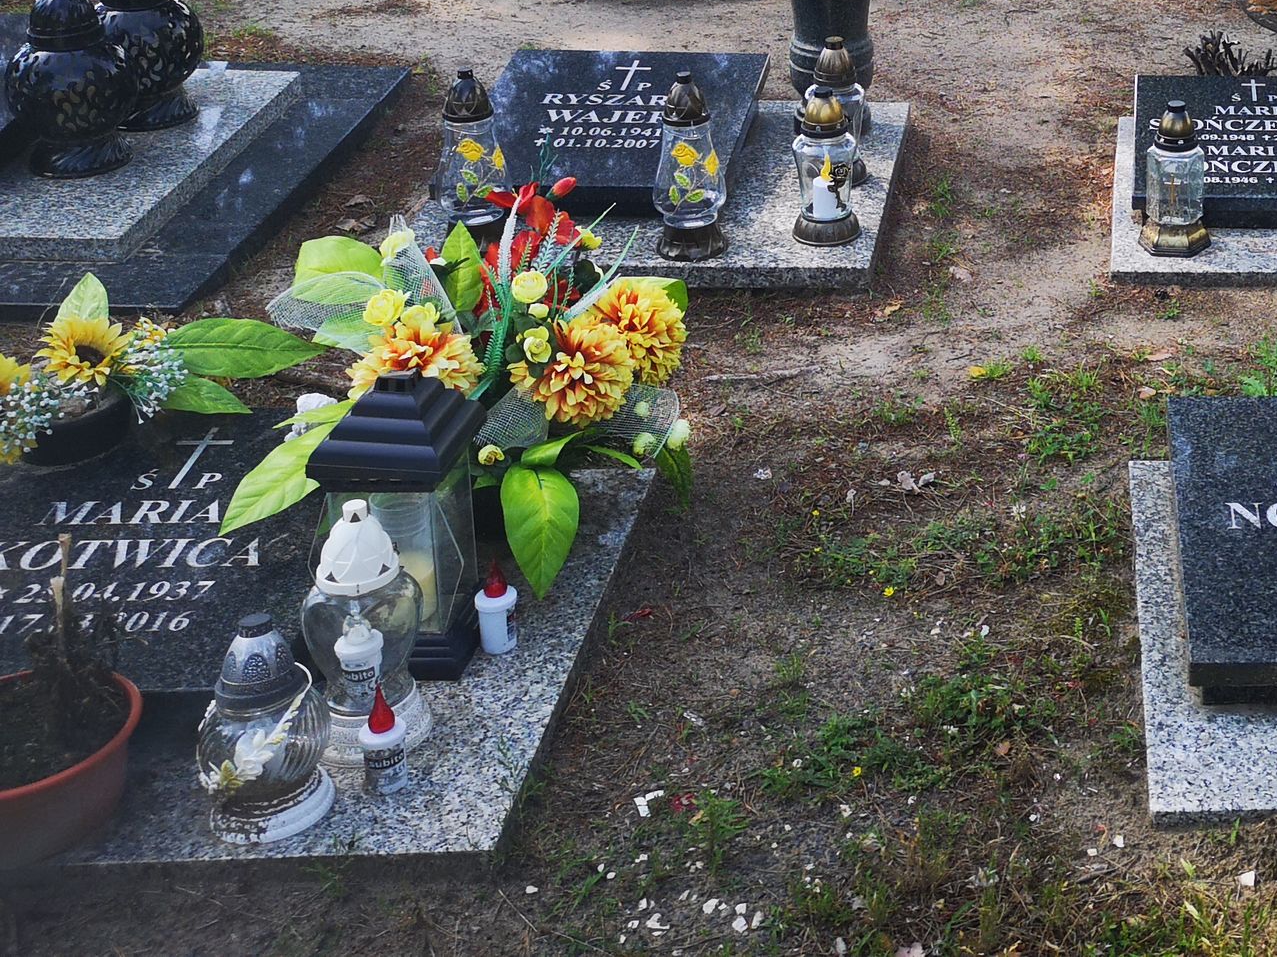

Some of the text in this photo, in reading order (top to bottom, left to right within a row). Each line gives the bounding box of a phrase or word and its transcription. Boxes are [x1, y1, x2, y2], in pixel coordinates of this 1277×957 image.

[597, 79, 652, 91] Ś P
[541, 93, 668, 106] RYSZAR
[560, 126, 662, 136] 10.06.1941
[553, 138, 660, 148] 01.10.2007
[131, 469, 223, 490] Ś P
[34, 499, 222, 526] MARIA
